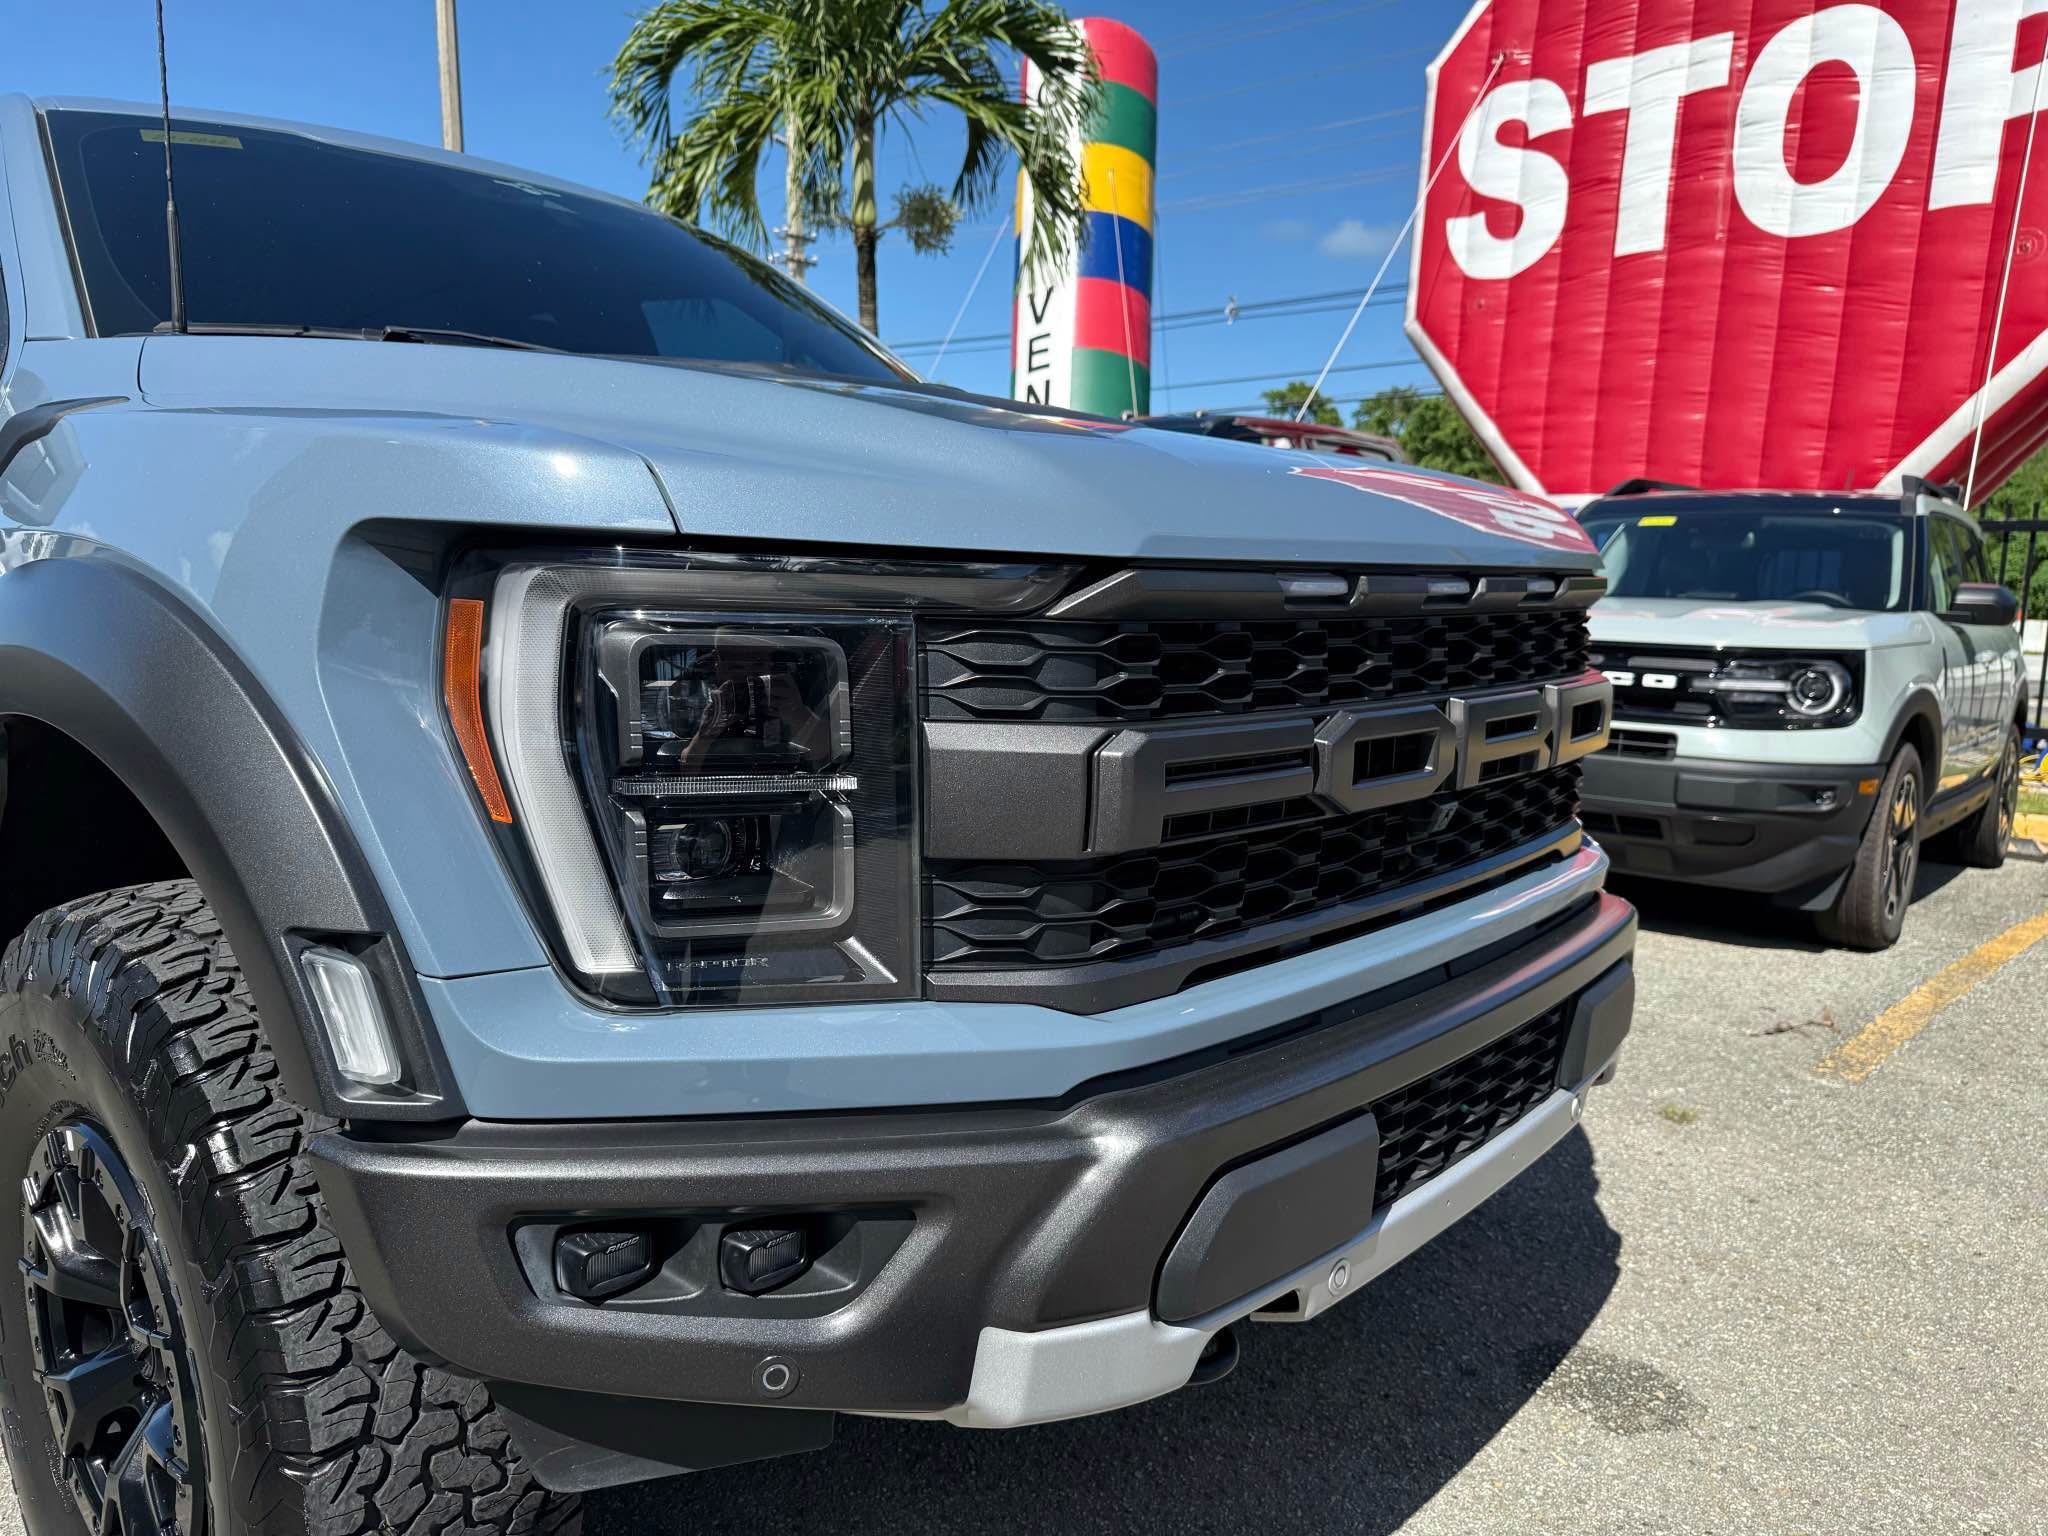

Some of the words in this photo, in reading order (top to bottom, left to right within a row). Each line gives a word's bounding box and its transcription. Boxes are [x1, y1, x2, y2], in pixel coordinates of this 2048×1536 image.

[1445, 0, 2048, 280] STOP
[1097, 682, 1613, 848] FORD
[606, 1236, 640, 1254] RIGID
